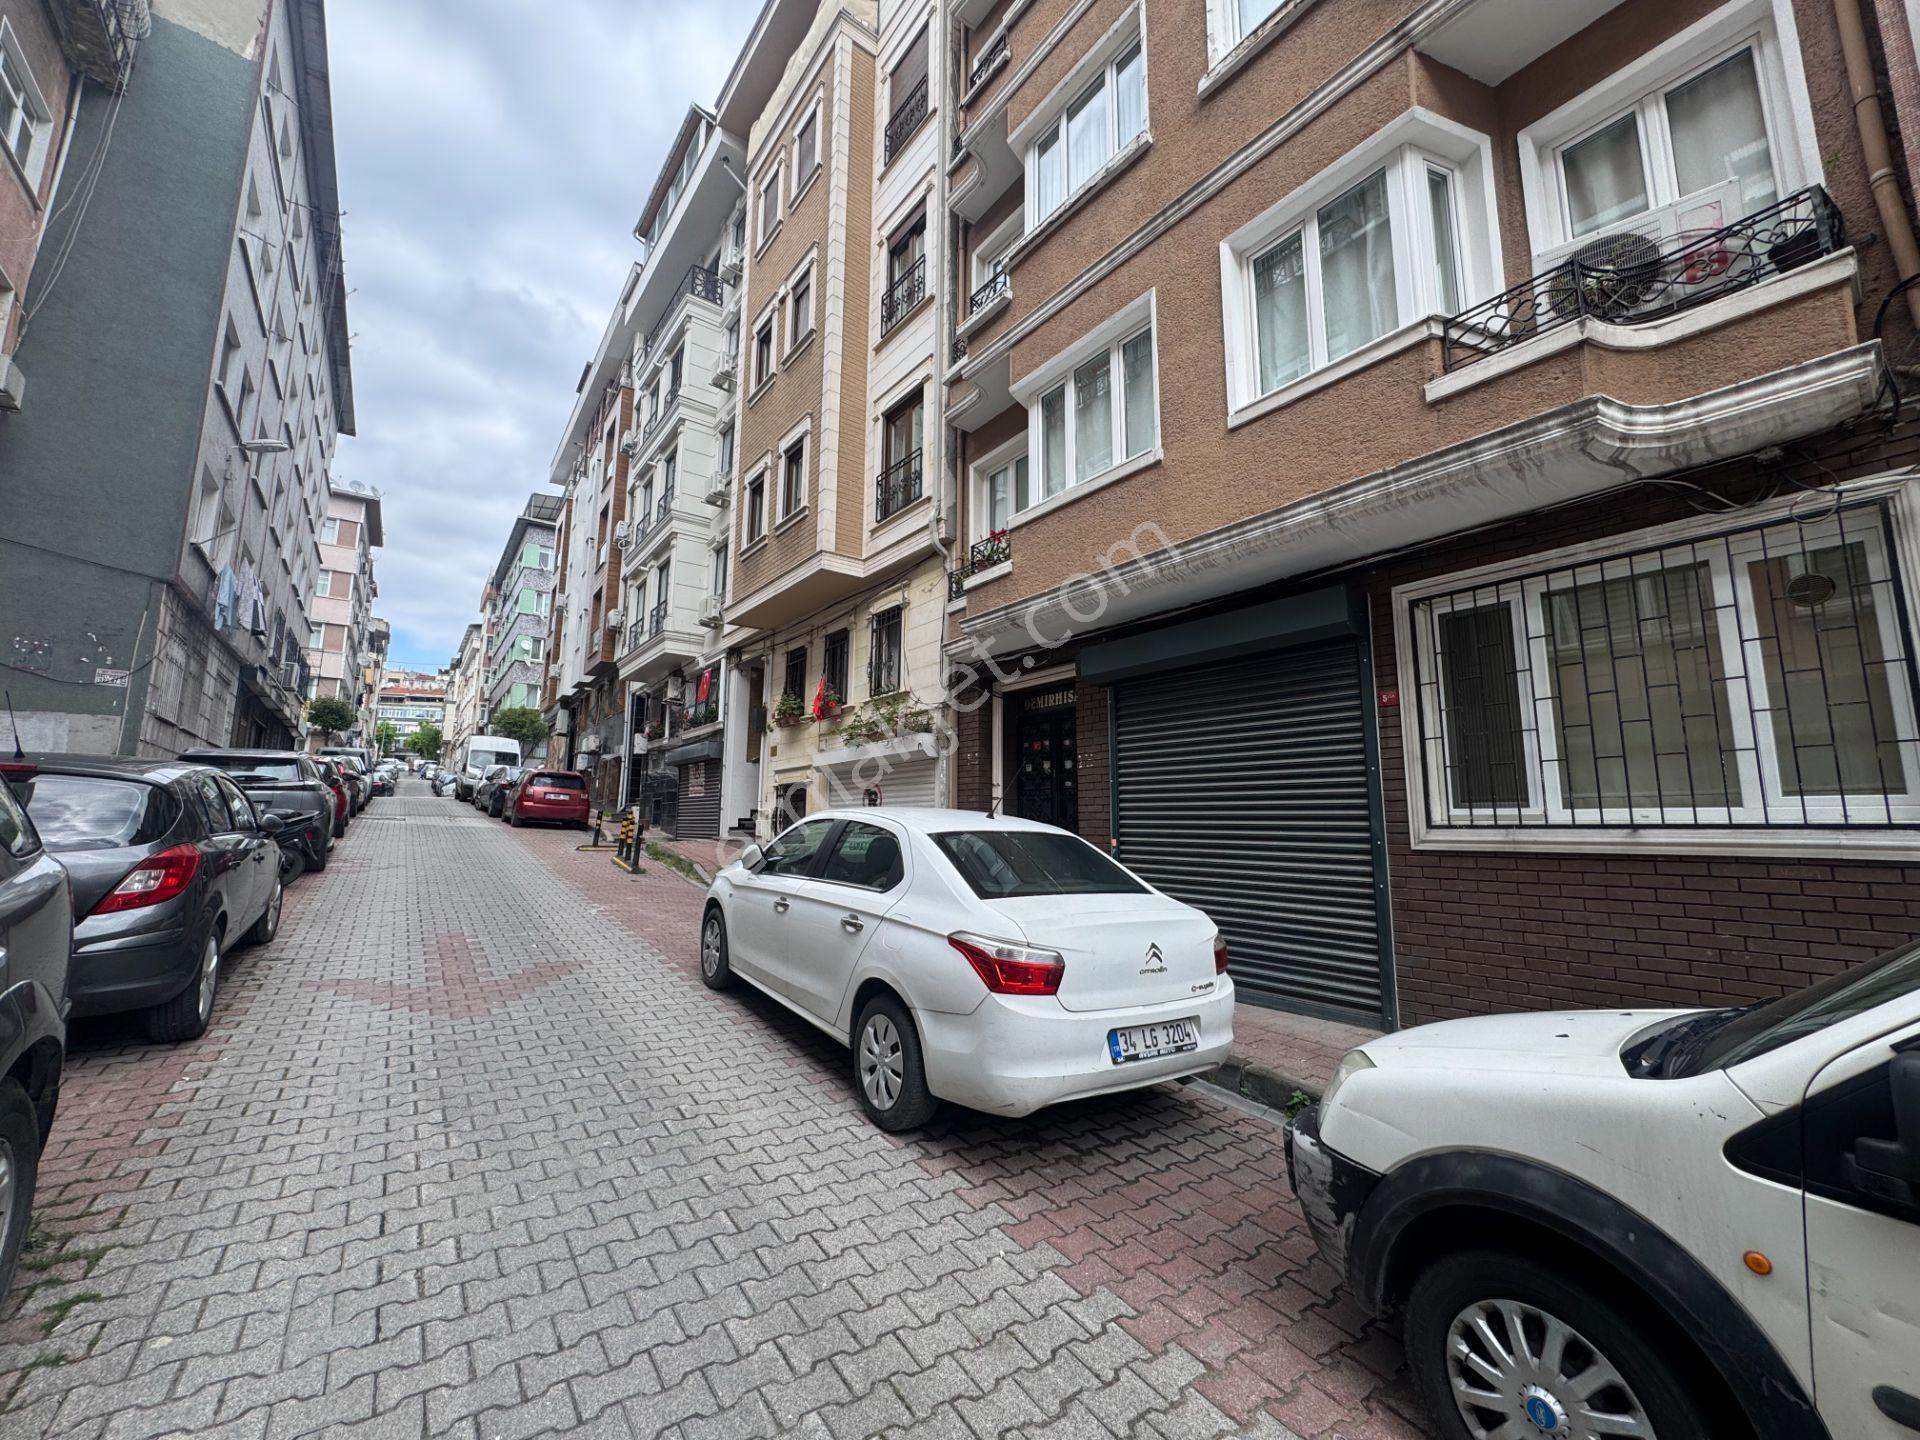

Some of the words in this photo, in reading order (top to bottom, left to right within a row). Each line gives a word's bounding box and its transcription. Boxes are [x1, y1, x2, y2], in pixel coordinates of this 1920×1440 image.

[1120, 1031, 1137, 1053] 34
[1142, 1028, 1159, 1049] LG
[1162, 1023, 1191, 1045] 3204
